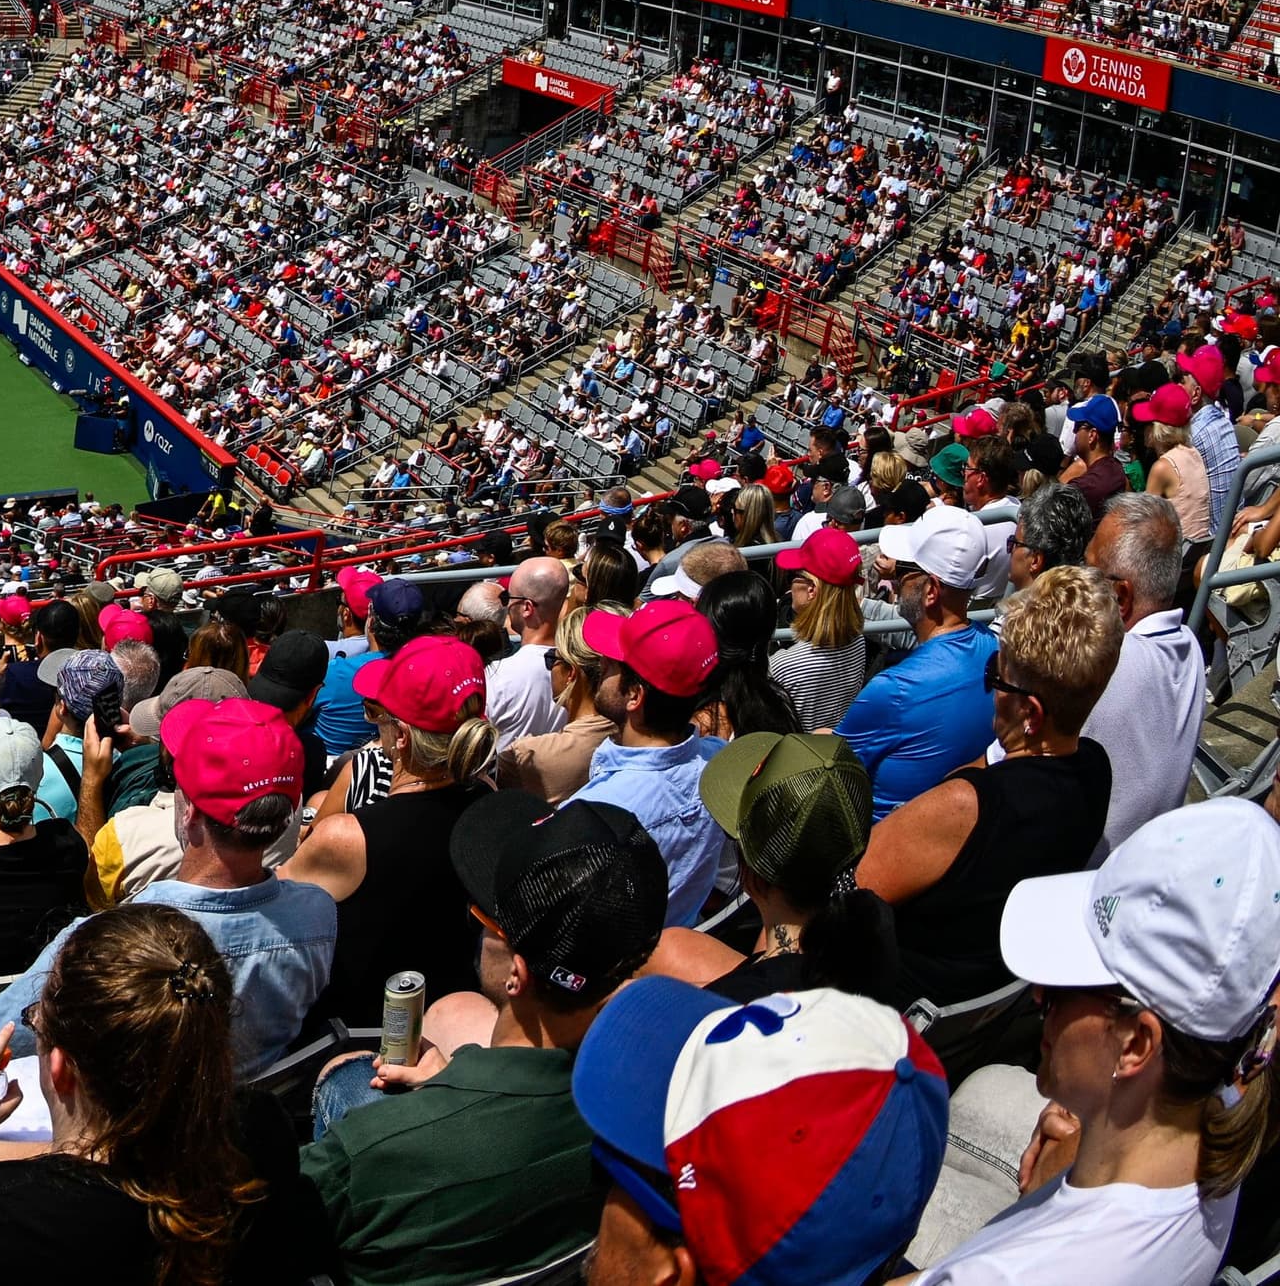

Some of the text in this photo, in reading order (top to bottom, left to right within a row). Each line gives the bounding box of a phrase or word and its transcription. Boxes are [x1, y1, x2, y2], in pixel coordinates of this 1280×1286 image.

[1091, 55, 1142, 80] TENNIS
[548, 84, 574, 99] NATIONALE
[549, 77, 569, 90] BANQUE
[1090, 72, 1146, 99] CANADA
[29, 313, 53, 341] BANQUE
[28, 327, 59, 363] NATIONALE
[154, 433, 173, 455] razr
[208, 462, 219, 479] 135
[1093, 900, 1111, 938] adidas
